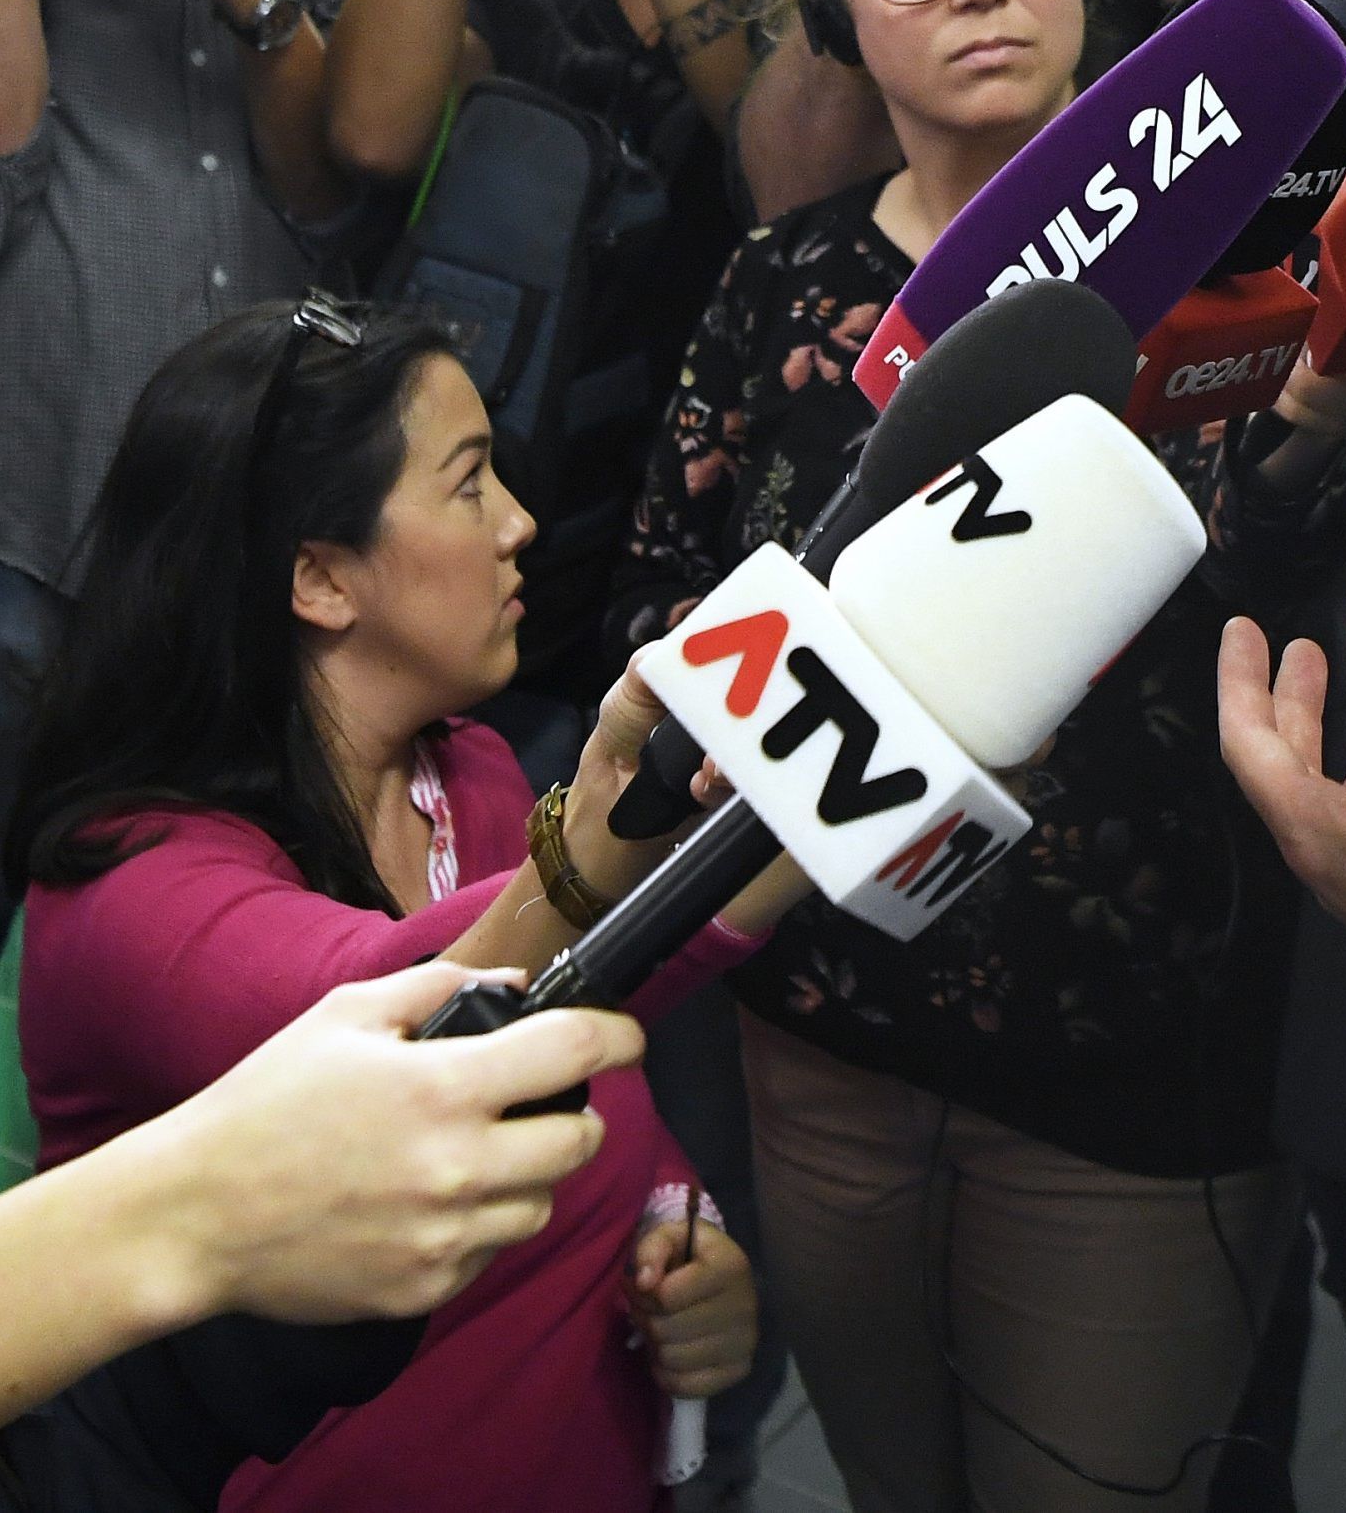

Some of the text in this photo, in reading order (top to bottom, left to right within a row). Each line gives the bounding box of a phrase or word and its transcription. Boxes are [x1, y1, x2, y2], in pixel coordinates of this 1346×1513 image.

[1128, 71, 1243, 193] 24
[1269, 165, 1346, 199] 24.TV
[1164, 342, 1299, 400] oe24.TV
[916, 453, 1033, 544] TV
[681, 609, 929, 828] ATV
[875, 809, 1011, 910] ATV
